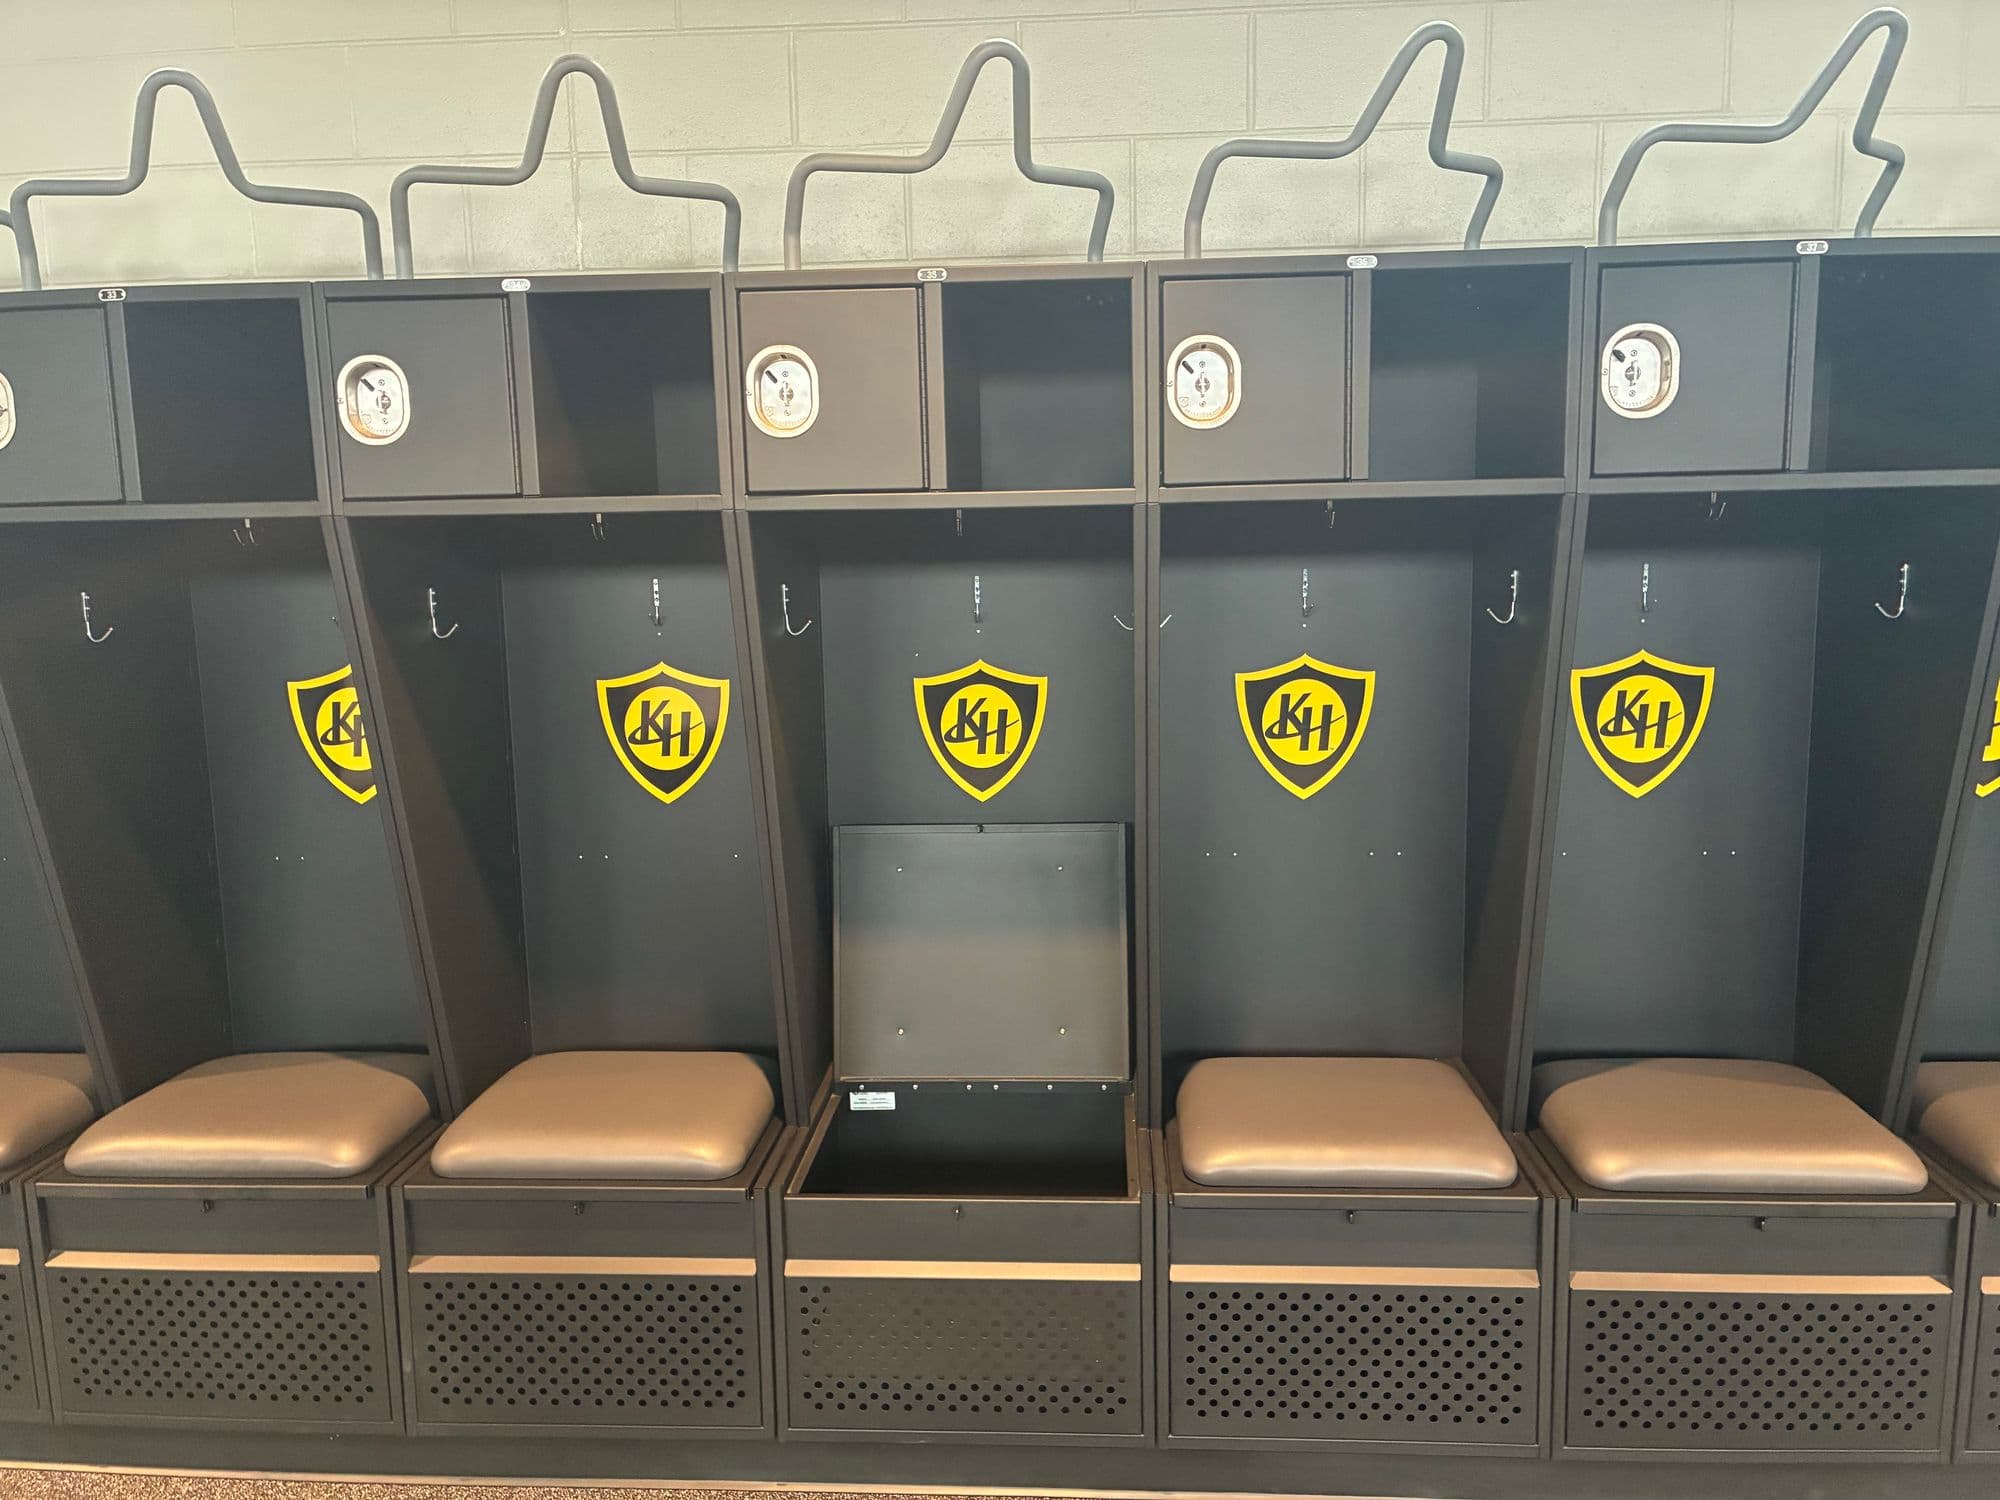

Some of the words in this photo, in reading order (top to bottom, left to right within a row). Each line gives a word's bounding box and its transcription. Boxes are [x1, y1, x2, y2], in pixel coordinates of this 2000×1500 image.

[629, 699, 703, 758] KH
[946, 698, 1020, 755] KH
[1265, 692, 1344, 751] KH
[1600, 688, 1682, 748] KH
